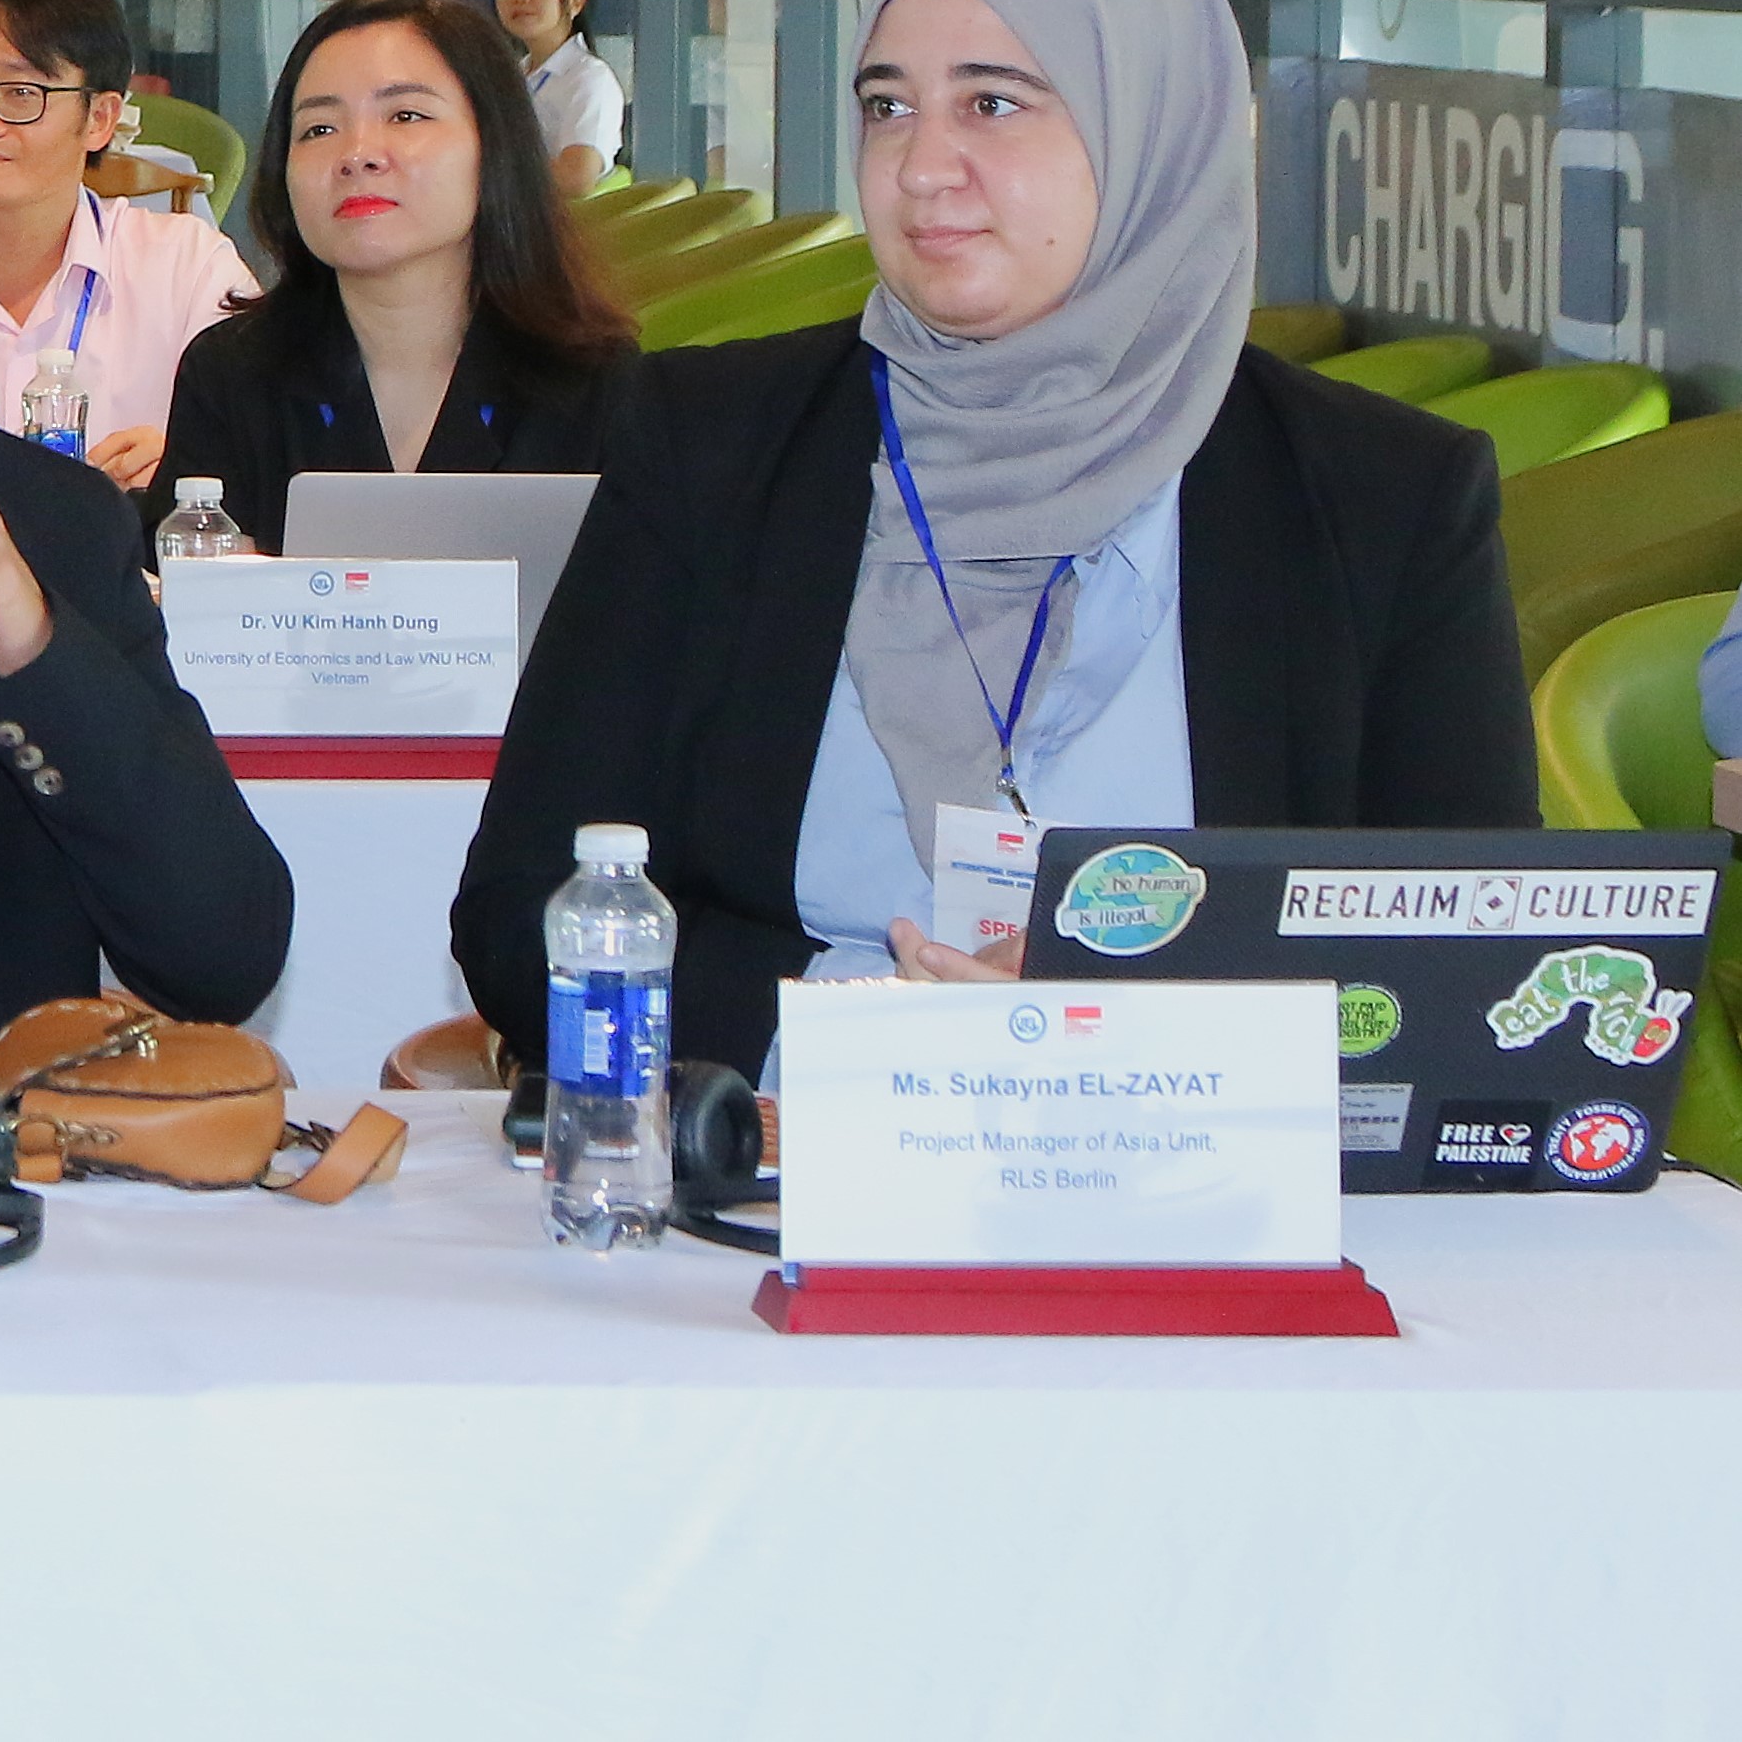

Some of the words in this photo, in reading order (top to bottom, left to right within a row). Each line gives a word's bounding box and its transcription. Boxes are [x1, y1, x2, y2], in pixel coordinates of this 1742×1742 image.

[242, 615, 266, 630] Dr.
[271, 615, 297, 630] VU
[302, 615, 337, 630] Kim
[342, 615, 387, 630] Hanh
[392, 615, 439, 634] Dung
[184, 652, 252, 668] University
[257, 652, 271, 665] of
[275, 652, 351, 665] Economics
[356, 652, 381, 665] and
[385, 652, 415, 665] Law
[418, 652, 451, 665] VNU
[311, 672, 369, 685] Vietnam
[1138, 874, 1191, 891] human
[1287, 883, 1459, 920] RECLAIM
[1529, 881, 1698, 918] CULTURE
[979, 919, 1017, 937] SPE
[1505, 988, 1555, 1032] eat
[1562, 958, 1610, 993] the
[1602, 991, 1638, 1052] rich
[892, 1073, 939, 1096] Ms.
[949, 1072, 1068, 1102] Sukayna
[1079, 1073, 1222, 1096] EL-ZAYAT
[1441, 1124, 1495, 1143] FREE
[899, 1131, 975, 1155] Project
[983, 1131, 1078, 1156] Manager
[1086, 1131, 1107, 1152] of
[1113, 1131, 1160, 1152] Asia
[1168, 1132, 1217, 1154] Unit,
[1436, 1144, 1532, 1164] PALESTINE
[1001, 1169, 1047, 1189] RLS
[1055, 1169, 1117, 1189] Berlin
